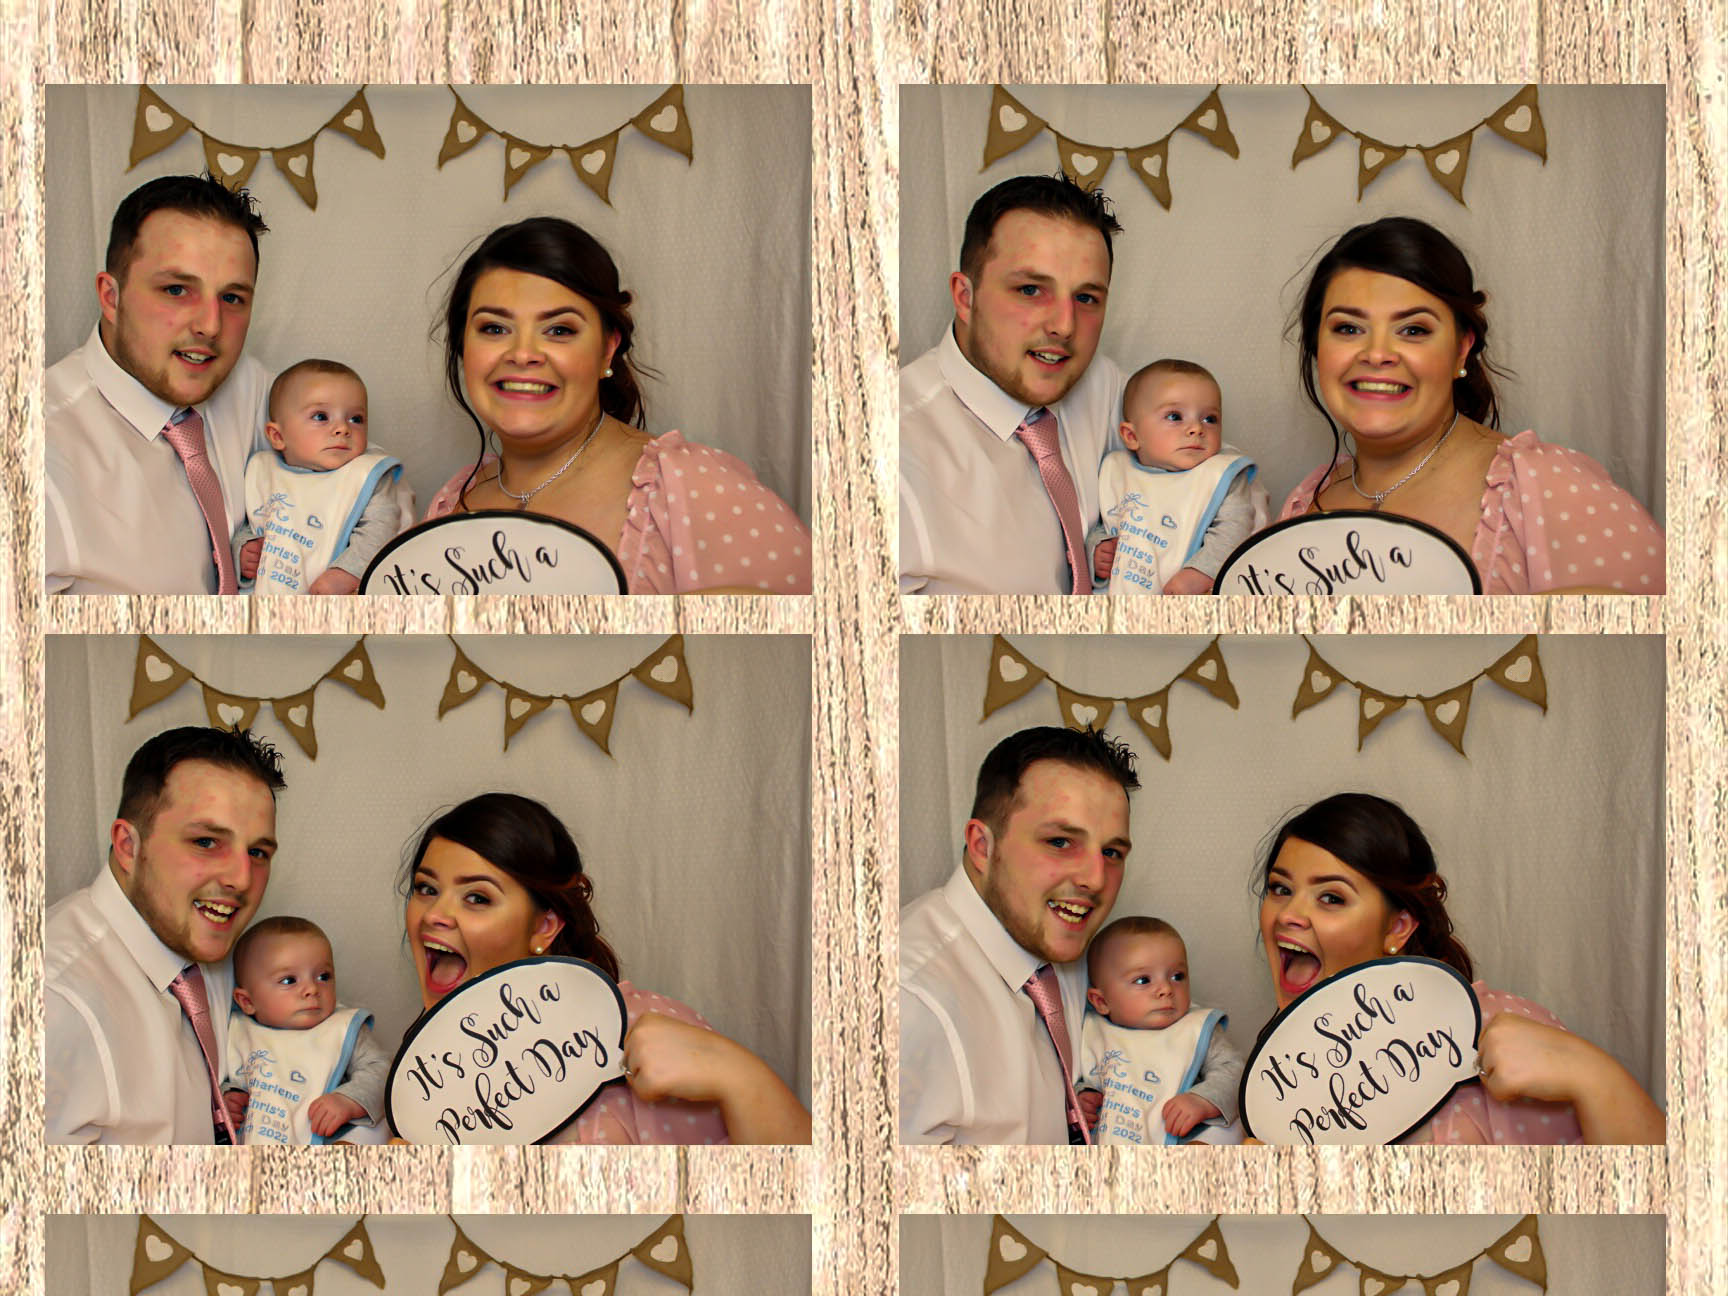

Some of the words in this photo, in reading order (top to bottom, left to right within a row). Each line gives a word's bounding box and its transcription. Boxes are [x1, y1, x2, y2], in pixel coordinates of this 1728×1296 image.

[271, 572, 299, 589] 2022
[444, 530, 532, 595] Such
[535, 546, 558, 568] a
[1125, 572, 1153, 589] 2022
[1298, 530, 1386, 595] Such
[1389, 546, 1412, 568] a
[407, 1051, 465, 1101] It's
[459, 983, 542, 1069] Such
[539, 981, 560, 1002] a
[1261, 1051, 1319, 1101] It's
[1313, 983, 1396, 1069] Such
[1393, 981, 1414, 1002] a
[435, 1072, 536, 1145] Perfect
[521, 1026, 609, 1083] Day
[1289, 1072, 1390, 1145] Perfect
[1375, 1026, 1463, 1083] Day
[258, 1127, 288, 1143] 2022
[1112, 1127, 1142, 1143] 2022
